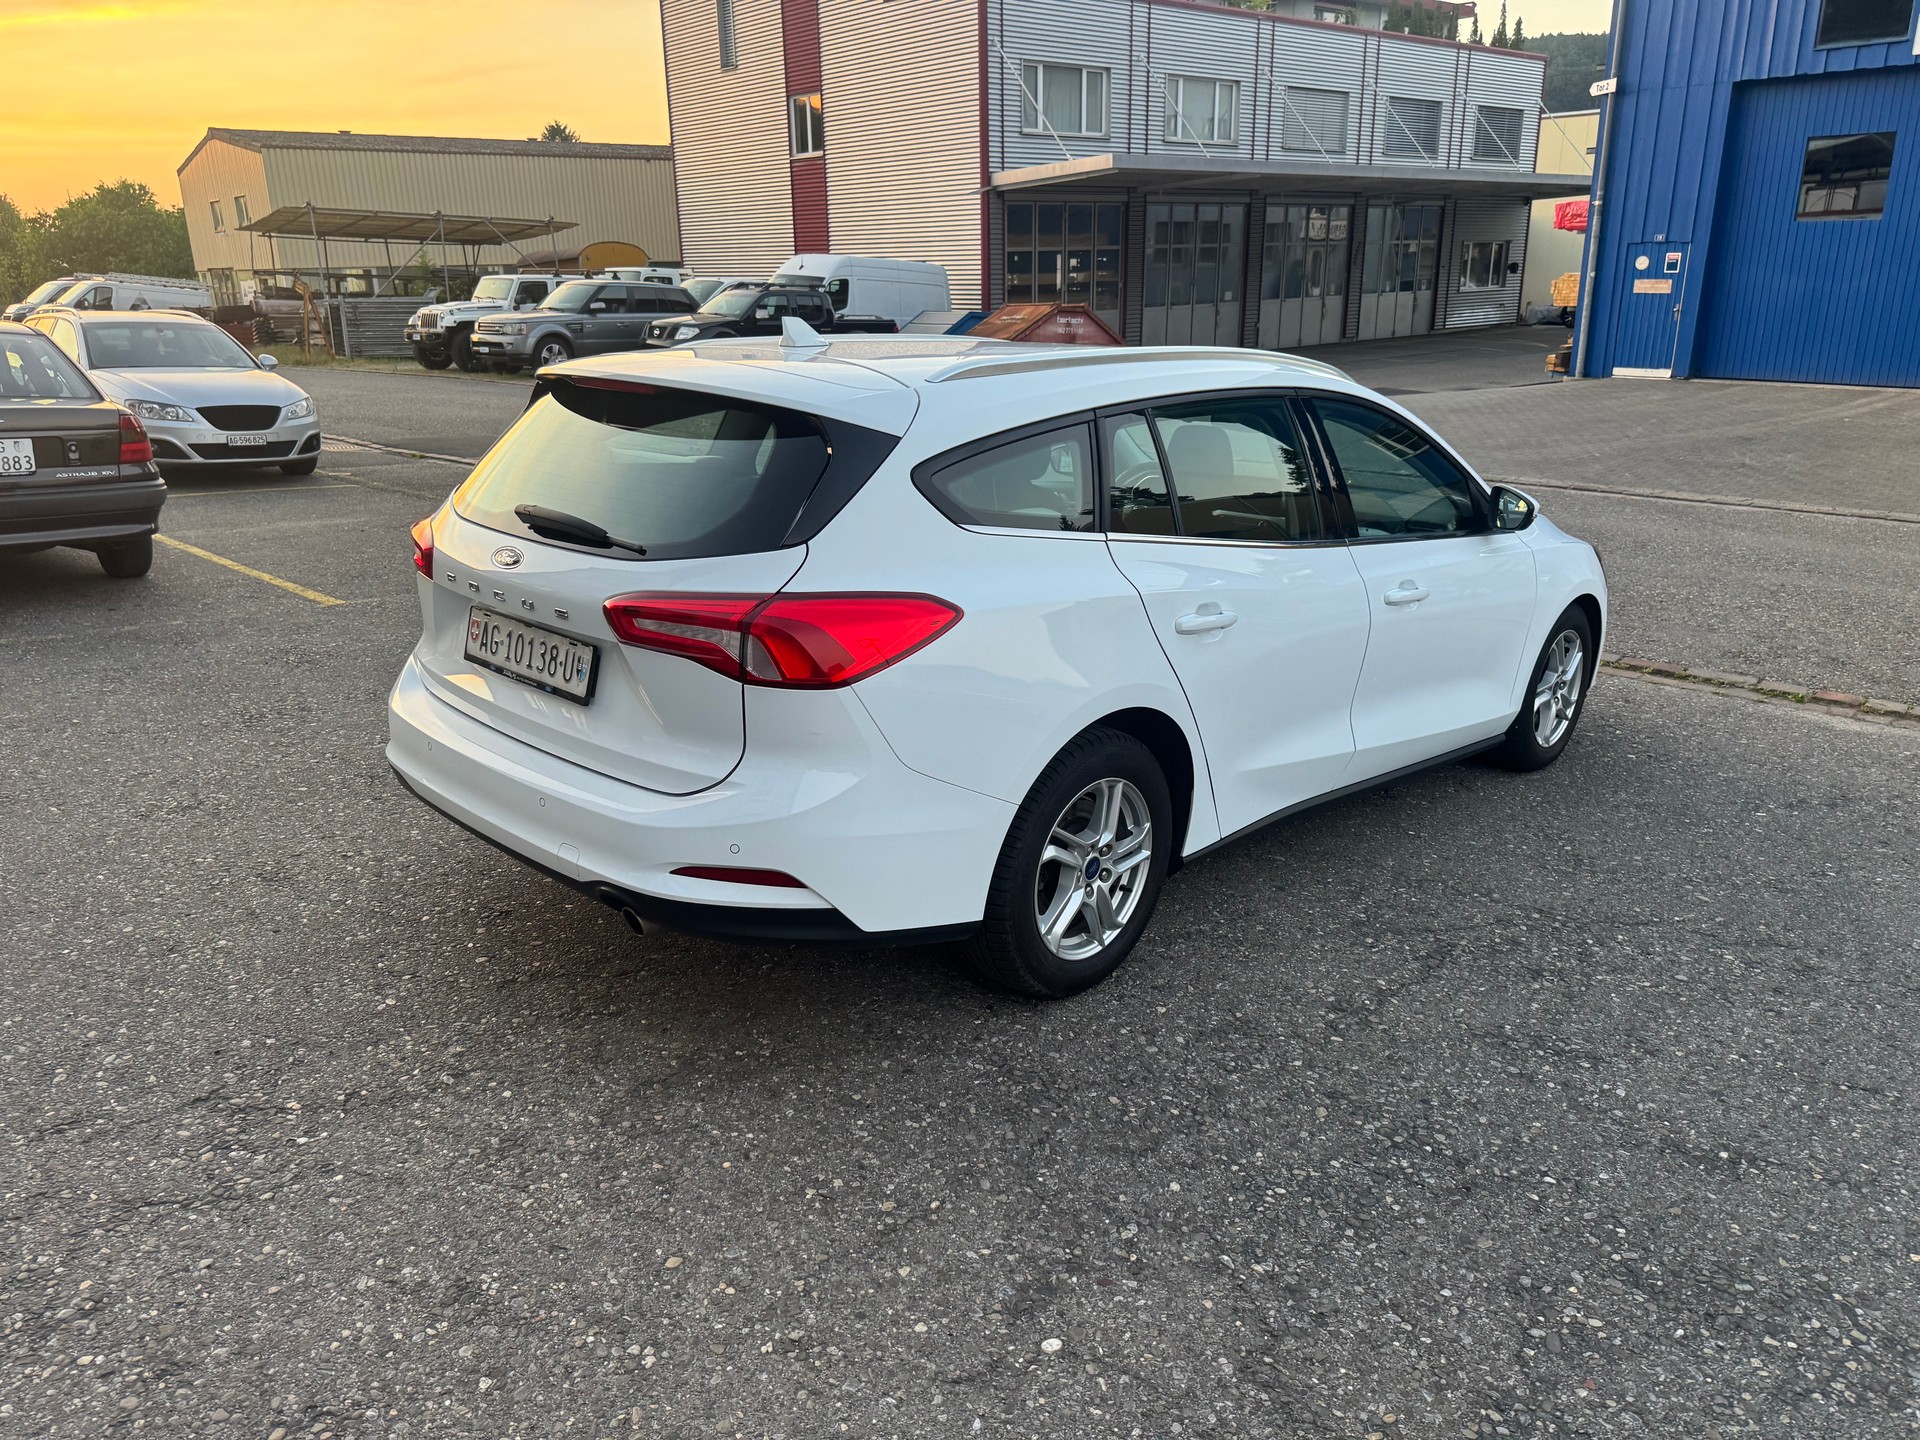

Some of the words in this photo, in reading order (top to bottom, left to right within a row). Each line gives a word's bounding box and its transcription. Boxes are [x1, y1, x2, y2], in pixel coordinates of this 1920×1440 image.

[1596, 84, 1605, 92] Tor
[55, 470, 88, 478] ASTRA
[495, 548, 519, 566] Ford
[446, 571, 569, 621] FOCUS
